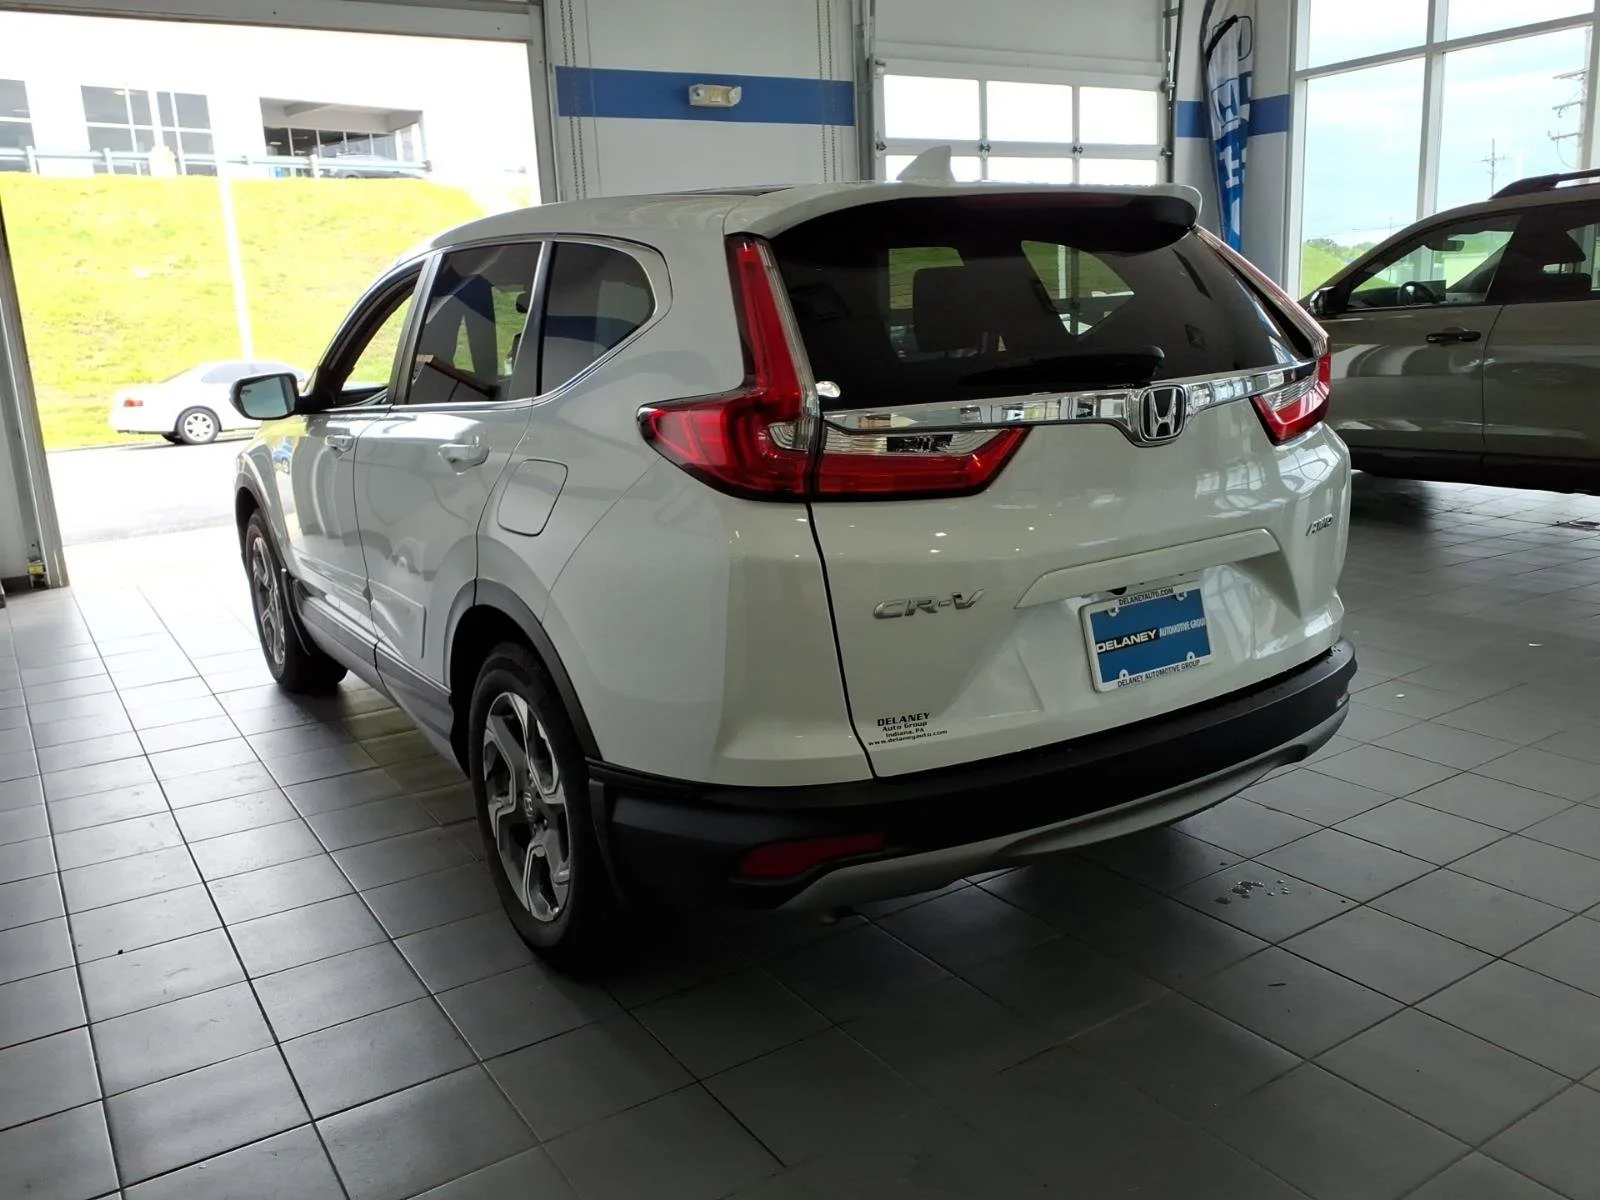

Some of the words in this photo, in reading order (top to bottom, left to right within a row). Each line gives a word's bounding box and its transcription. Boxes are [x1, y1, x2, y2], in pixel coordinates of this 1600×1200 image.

[873, 588, 985, 619] CR-V
[1118, 587, 1174, 605] DELANEYAUTO.COM
[1096, 629, 1156, 653] DELANEY
[1159, 621, 1190, 638] AUTOMOTIVE
[1117, 675, 1144, 688] DELANEY
[1145, 664, 1181, 680] AUTOMOTIVE
[1181, 659, 1200, 670] GROUP
[877, 712, 930, 727] DELANEY
[904, 721, 928, 729] Group
[886, 730, 914, 738] Indiana,
